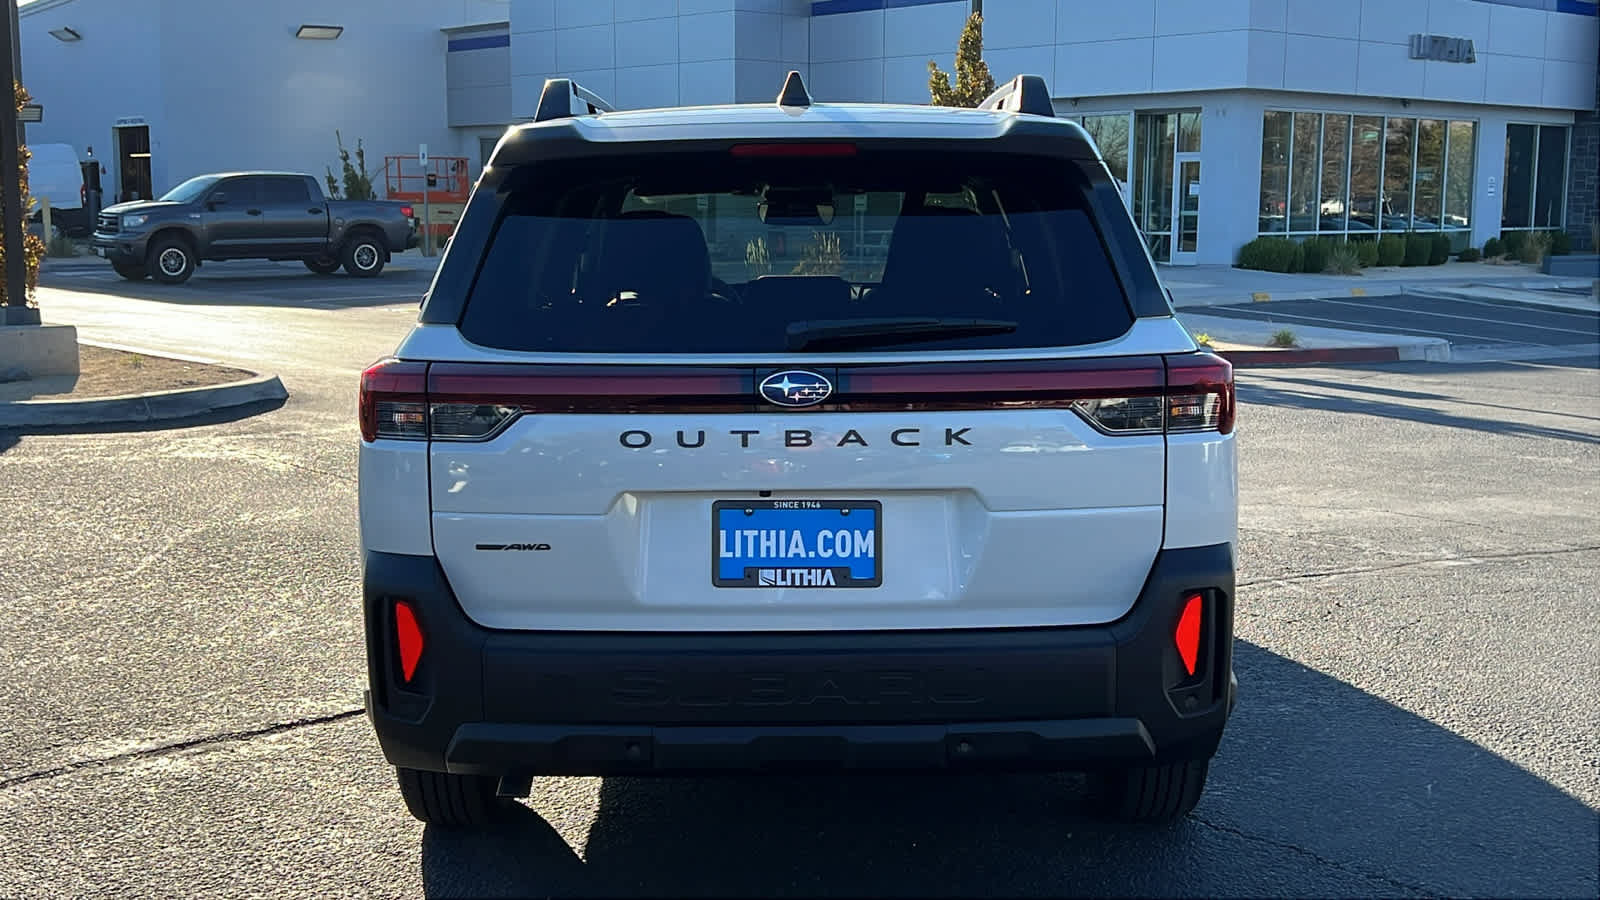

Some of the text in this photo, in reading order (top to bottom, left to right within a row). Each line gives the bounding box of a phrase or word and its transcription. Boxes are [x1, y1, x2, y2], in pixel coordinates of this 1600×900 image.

[619, 428, 973, 449] OUTBACK
[773, 501, 821, 509] SINCE 1946
[503, 543, 551, 551] AWD
[719, 529, 875, 558] LITHIA.COM
[775, 569, 836, 586] LITHIA
